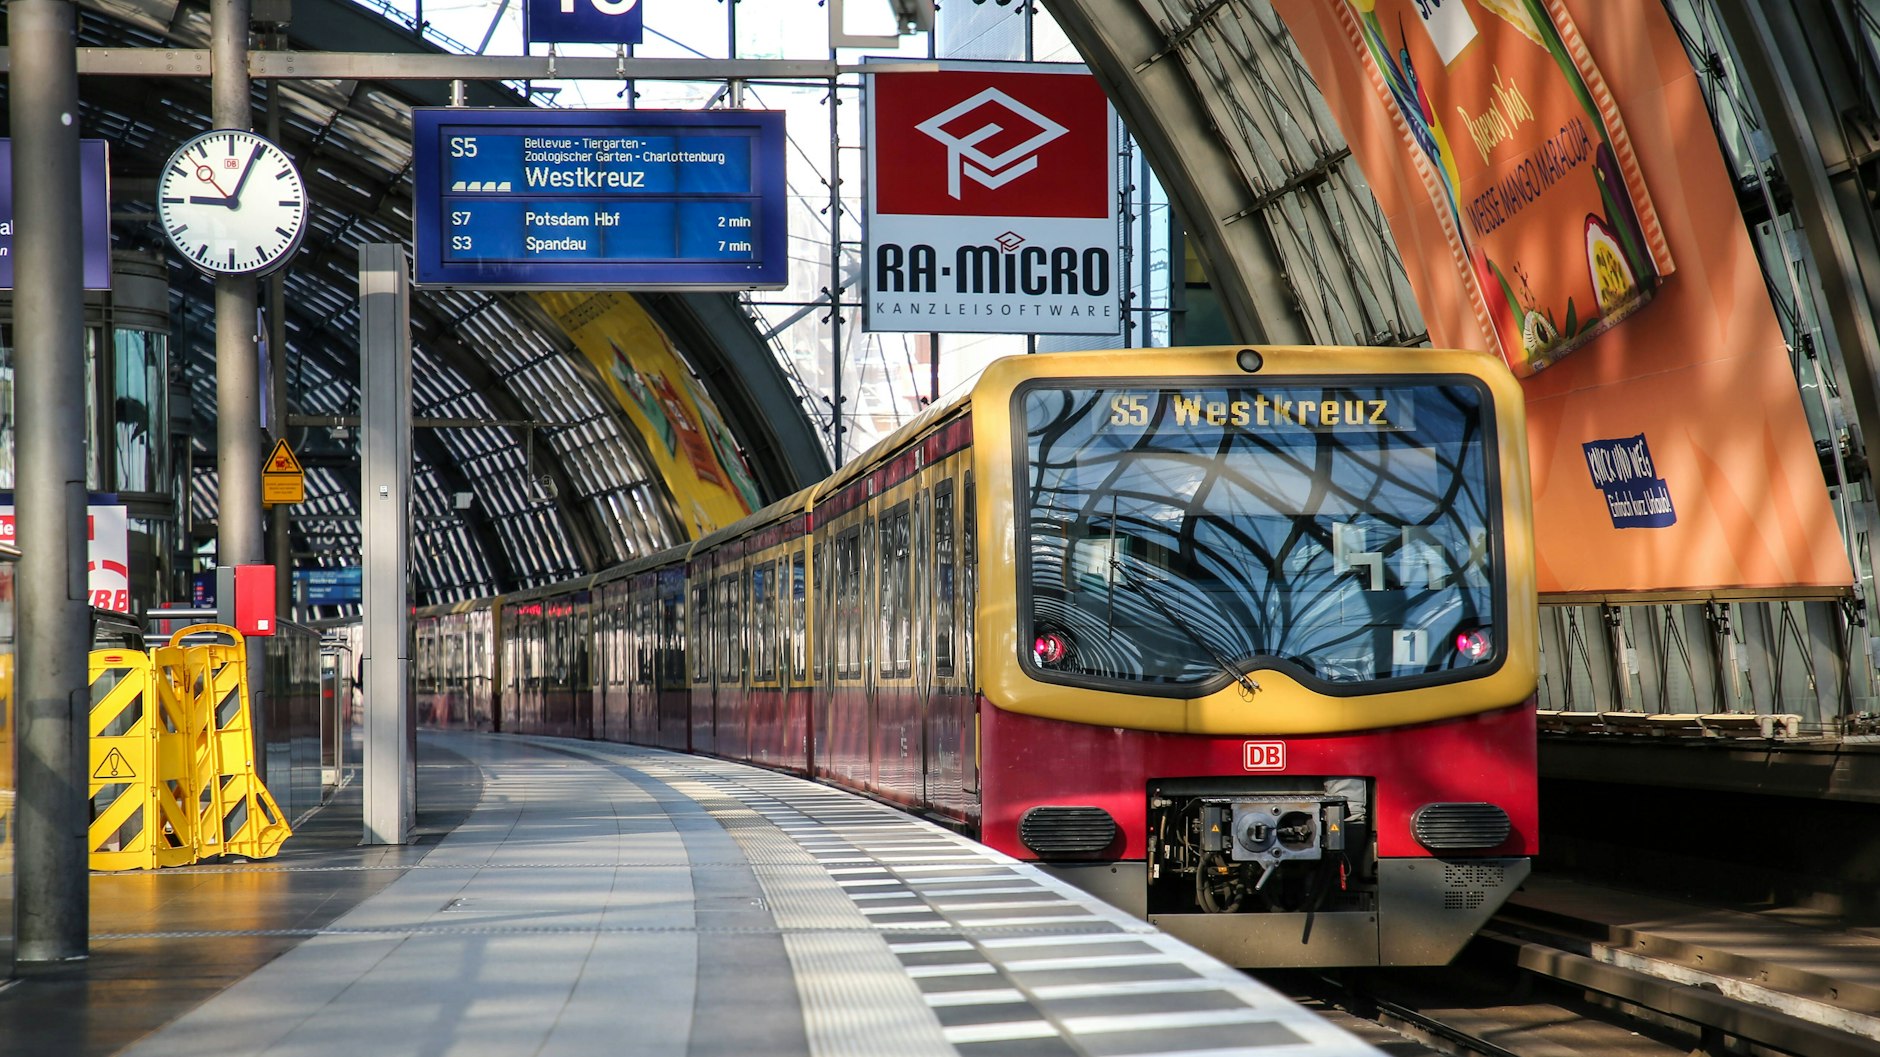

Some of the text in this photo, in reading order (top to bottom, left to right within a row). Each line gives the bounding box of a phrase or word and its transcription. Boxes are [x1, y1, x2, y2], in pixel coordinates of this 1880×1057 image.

[1456, 98, 1513, 167] Buenos
[450, 137, 478, 158] S5
[524, 138, 572, 149] Bellevue
[582, 138, 639, 151] Tiergarten
[524, 151, 593, 164] Zoologischer
[595, 152, 633, 162] Garten
[643, 151, 726, 164] Charlottenburg
[525, 166, 645, 188] Westkreuz
[1465, 116, 1593, 238] WEISSE MANGO MARACUJA
[451, 211, 752, 227] S7 Potsdam Hbf 2 min
[452, 235, 752, 254] S3 Spandau 7 min
[876, 302, 1111, 317] KANZLEISOFTWARE
[1110, 394, 1388, 427] S5 Westkreuz
[1587, 439, 1653, 486] KNICK UND WEG
[88, 589, 128, 612] BB
[1402, 632, 1416, 662] 1
[1248, 745, 1282, 766] DB
